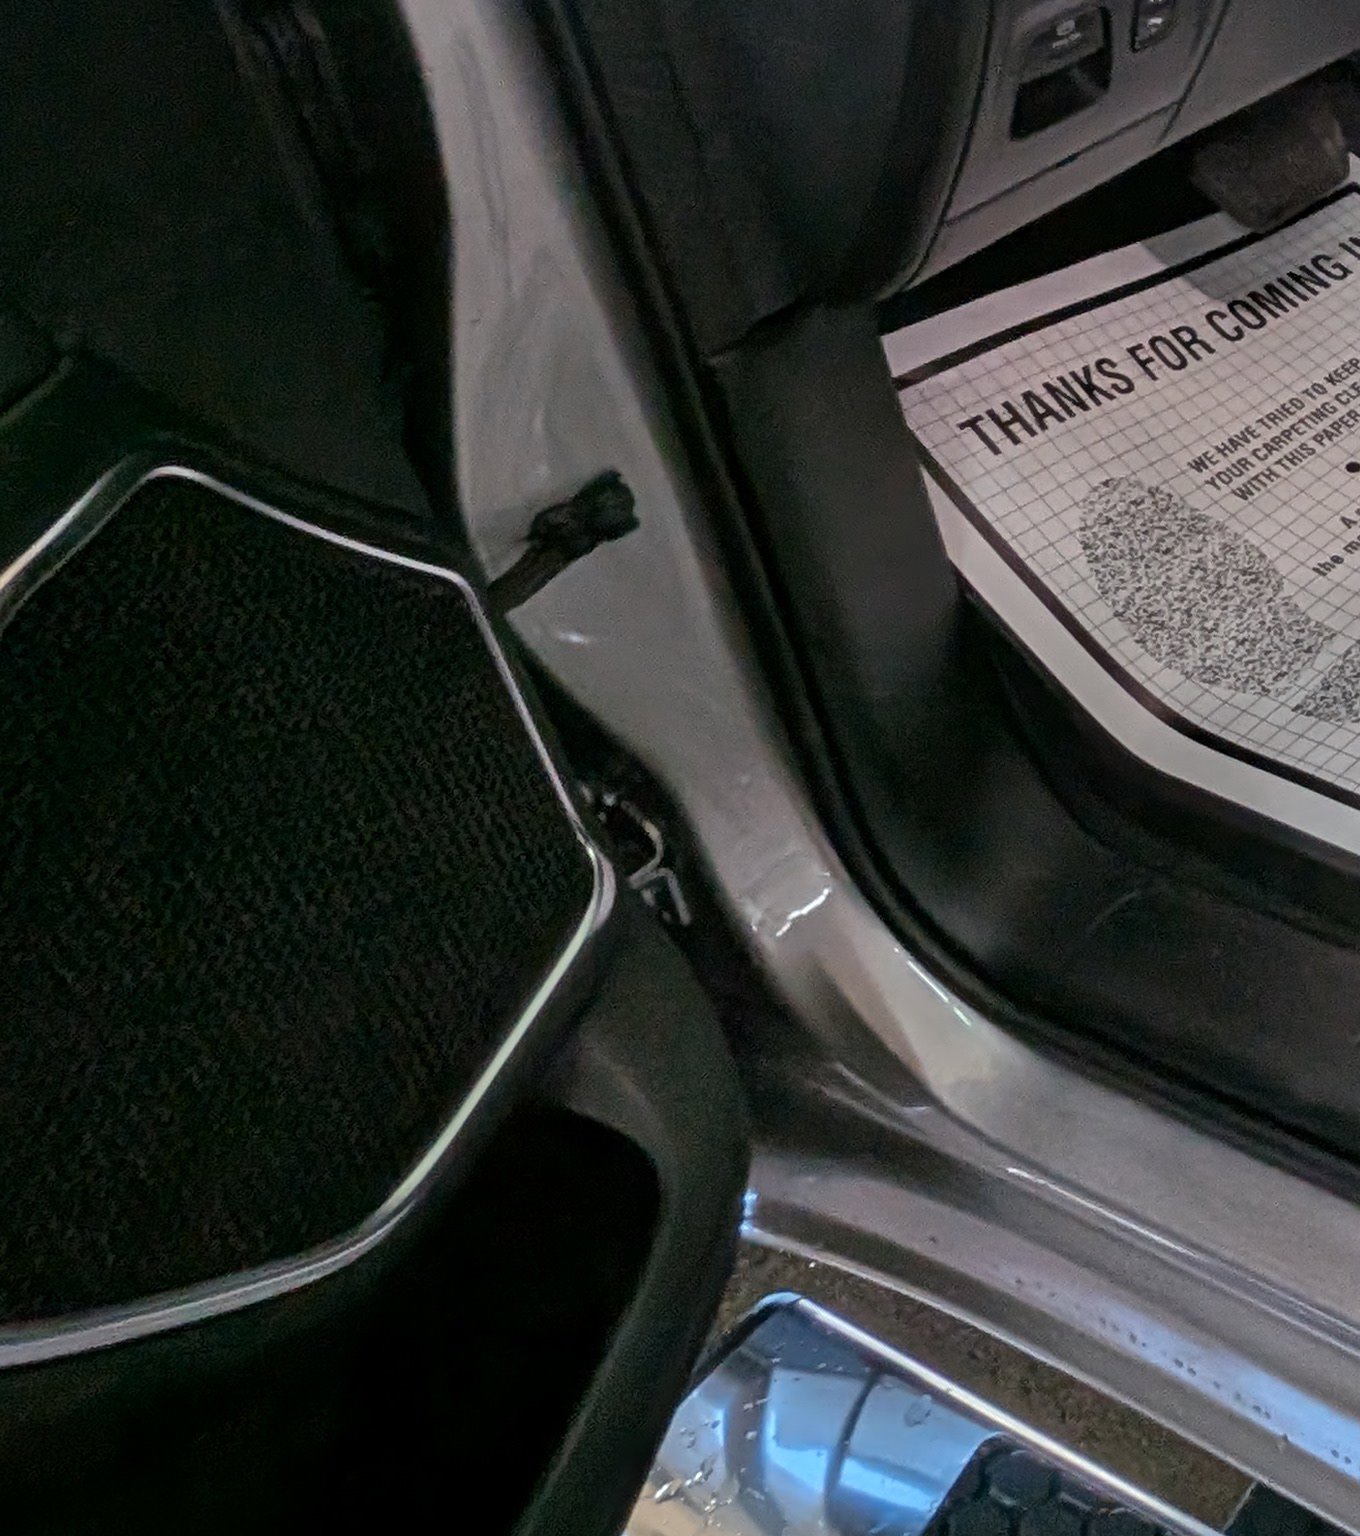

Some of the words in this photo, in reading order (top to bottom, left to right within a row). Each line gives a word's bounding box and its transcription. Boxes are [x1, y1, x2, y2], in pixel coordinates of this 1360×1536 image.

[958, 357, 1136, 456] THANKS
[1126, 325, 1216, 382] FOR
[1205, 253, 1354, 342] COMING
[1187, 450, 1220, 474] WE
[1214, 425, 1262, 458] HAVE
[1256, 397, 1306, 431] TRIED
[1302, 382, 1328, 401] TO
[1204, 457, 1254, 492] YOUR
[1251, 401, 1338, 462] CARPETING
[1231, 467, 1282, 501] WITH
[1273, 442, 1317, 472] THIS
[1340, 516, 1358, 530] A
[1312, 554, 1345, 577] the
